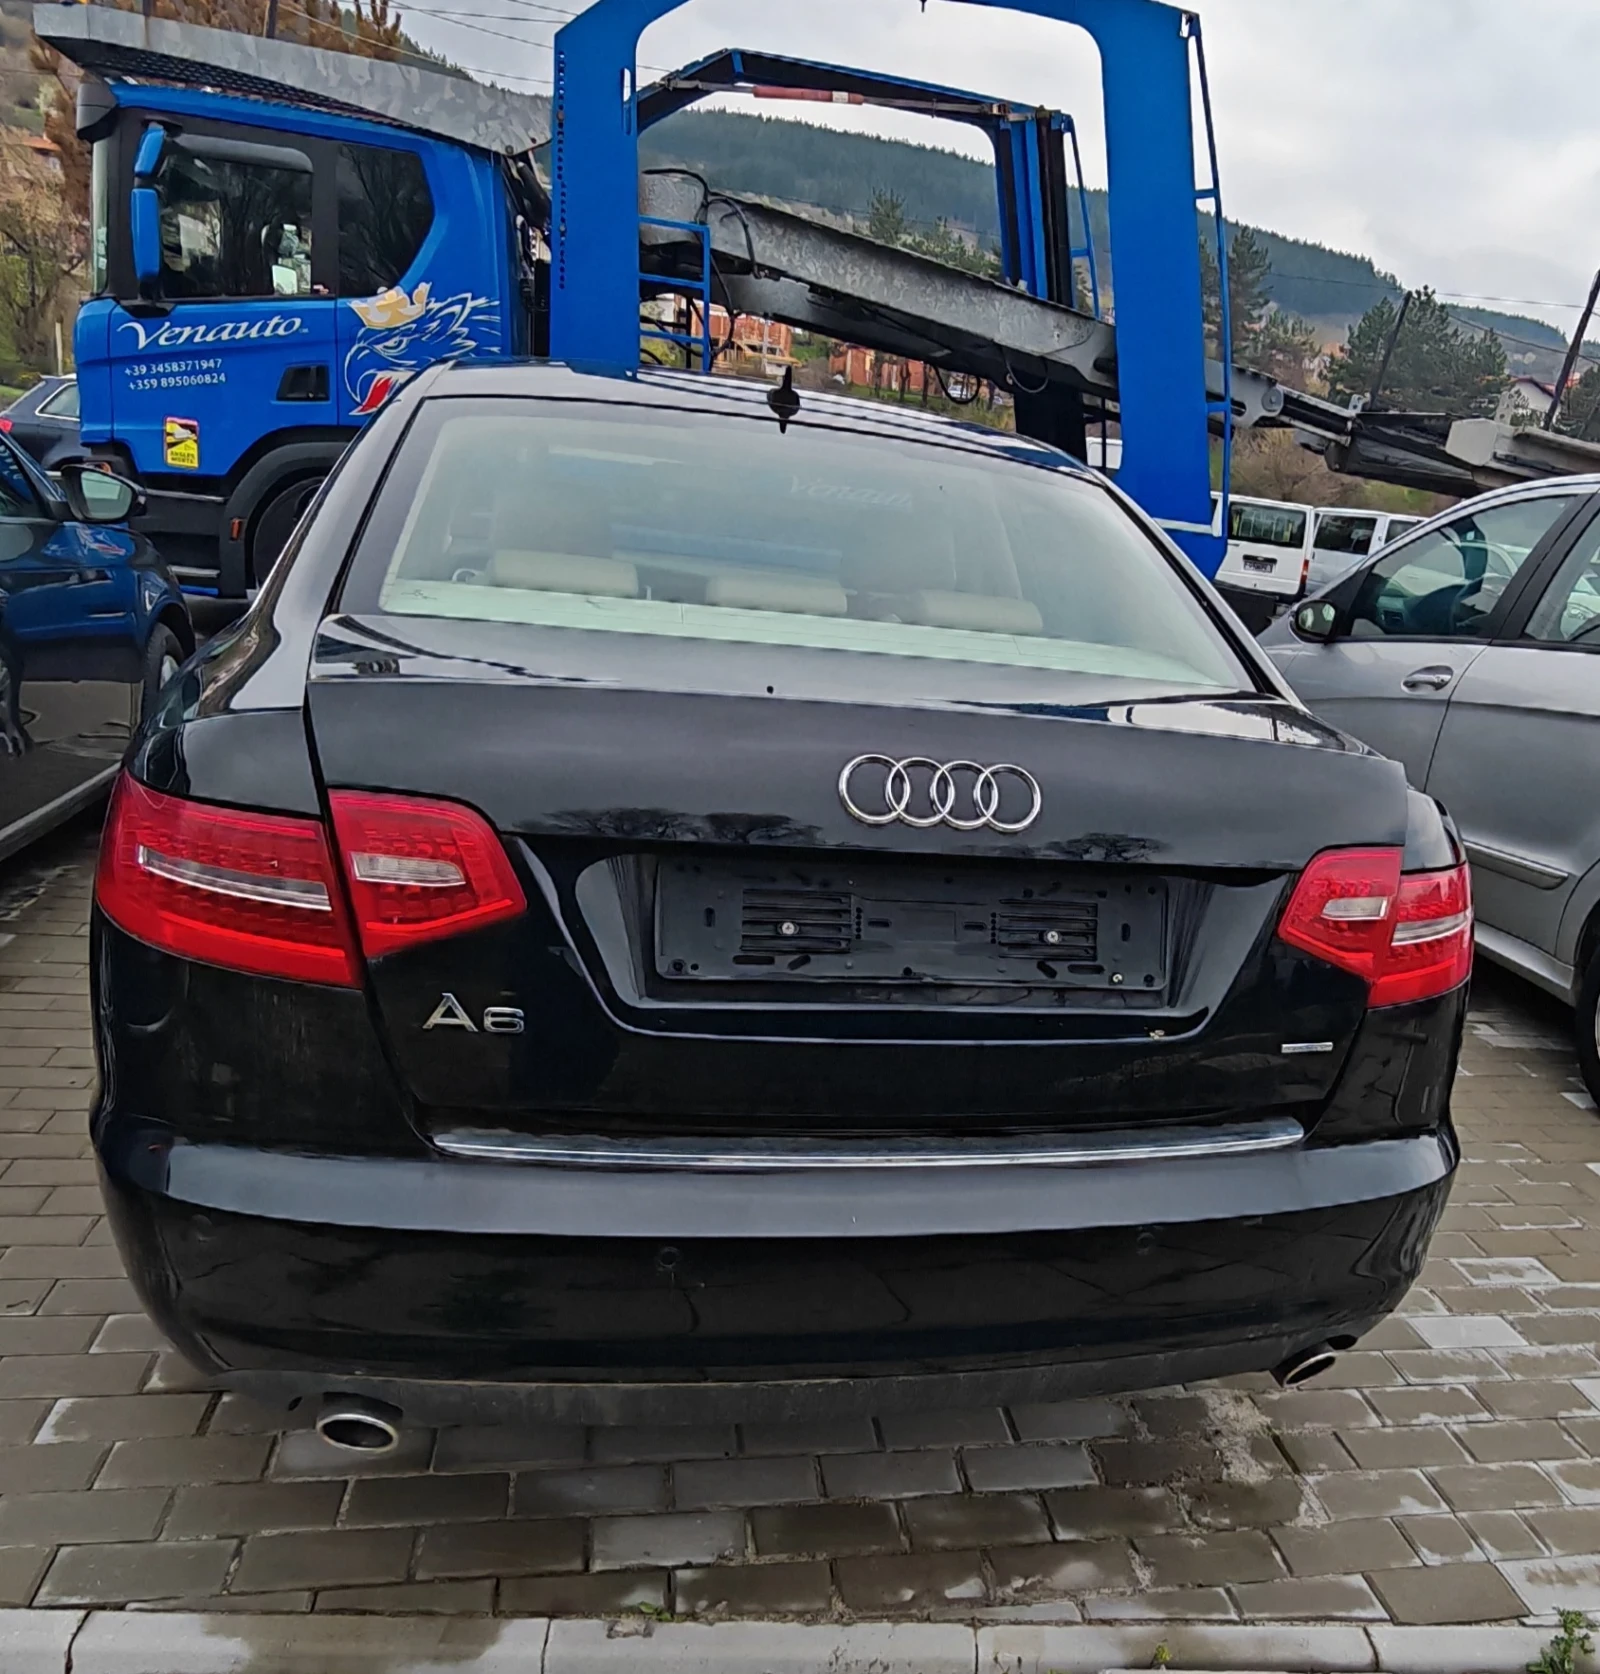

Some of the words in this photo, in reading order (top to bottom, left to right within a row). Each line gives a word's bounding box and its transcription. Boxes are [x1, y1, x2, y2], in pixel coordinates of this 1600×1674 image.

[116, 314, 302, 350] Venauto
[124, 365, 147, 377] +39
[150, 358, 222, 375] 3458371947
[129, 377, 158, 391] +359
[160, 372, 226, 388] 895060824
[422, 992, 525, 1033] A6
